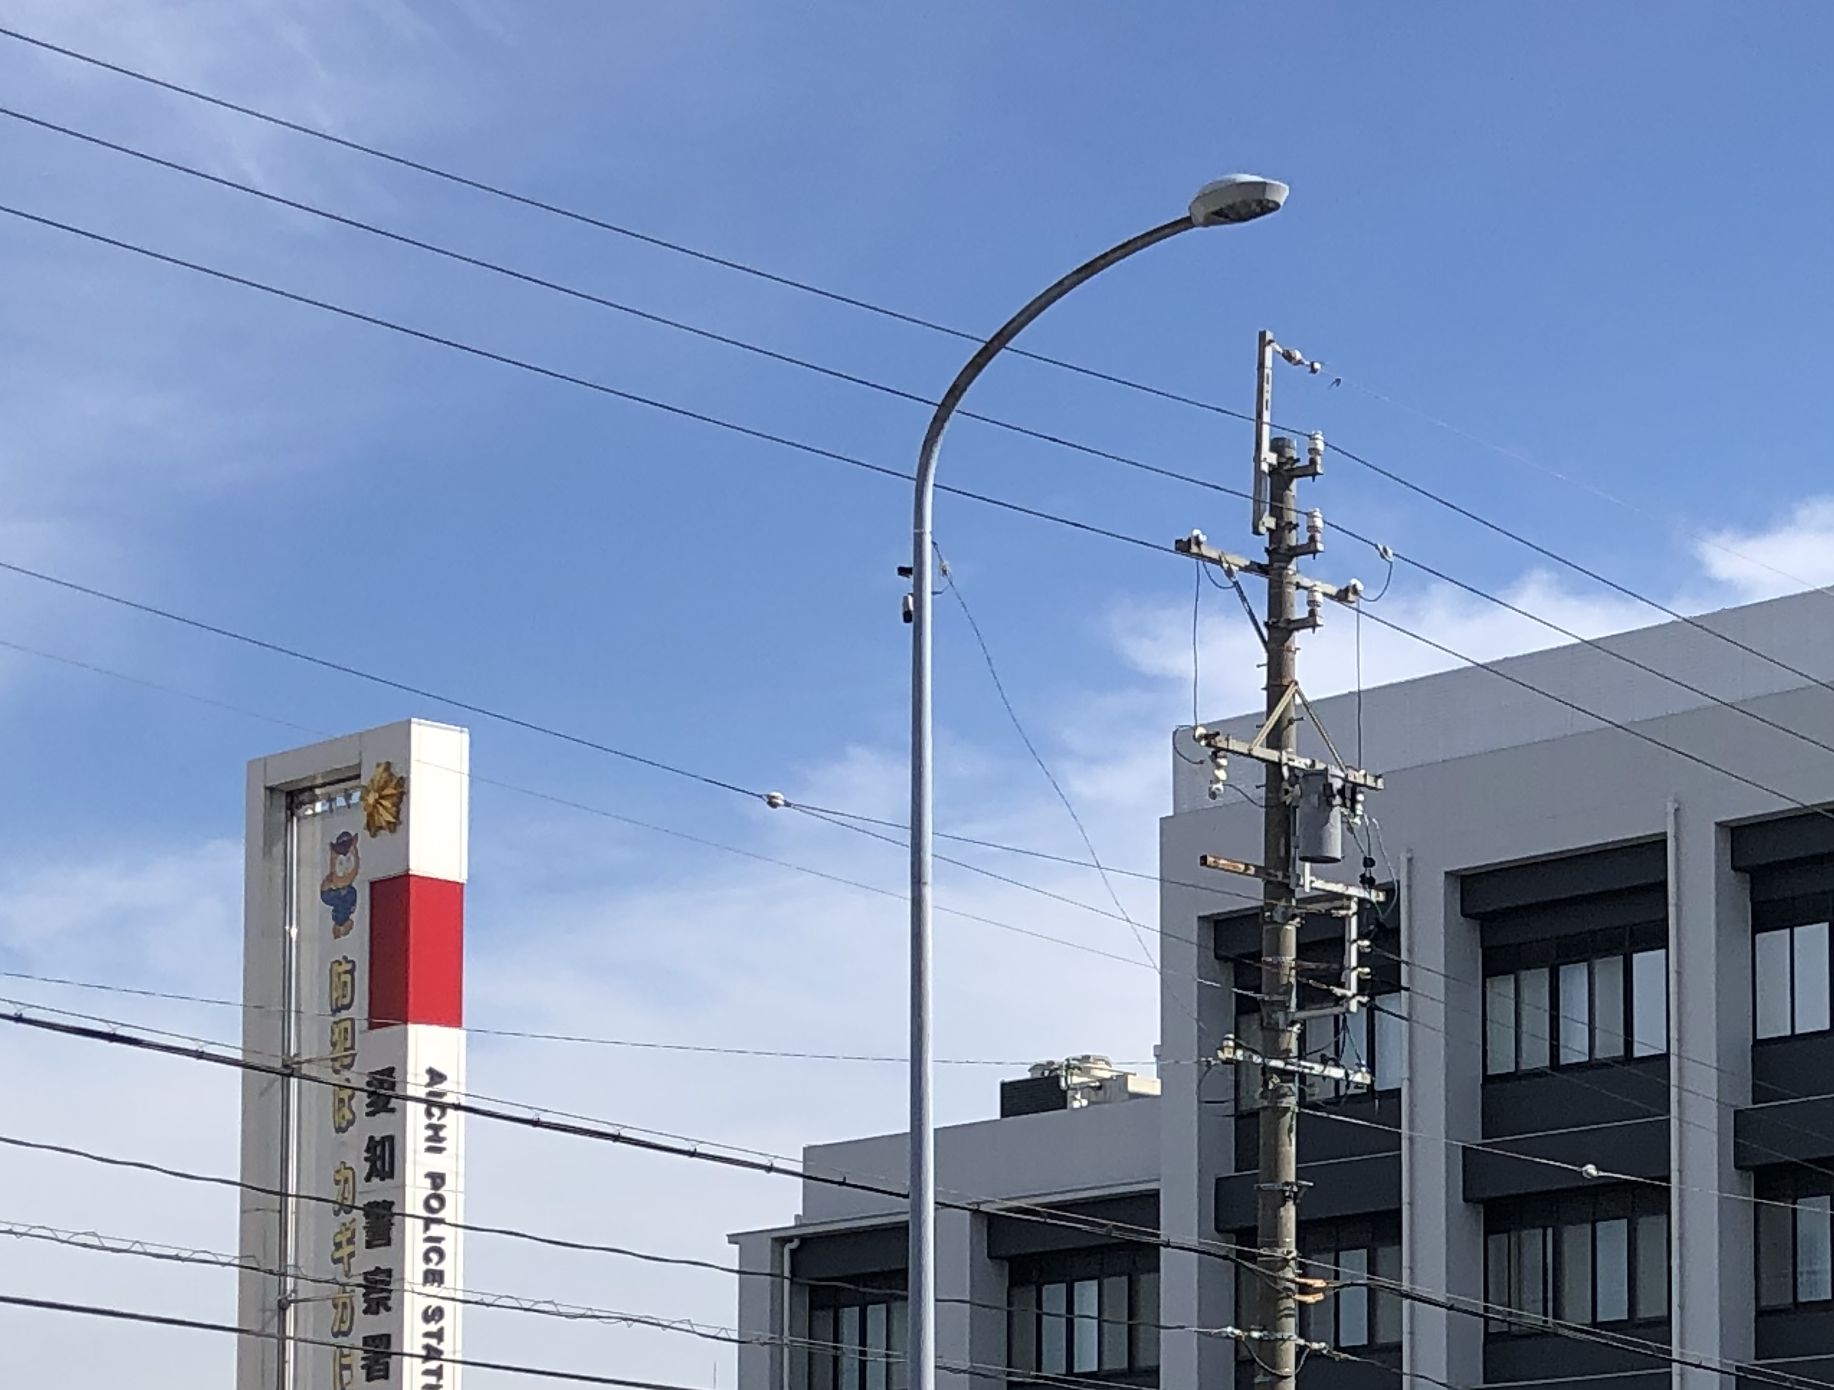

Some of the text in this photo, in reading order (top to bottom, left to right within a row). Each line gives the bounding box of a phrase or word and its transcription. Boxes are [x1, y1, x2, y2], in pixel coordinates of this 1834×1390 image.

[329, 955, 357, 1134] 防犯は
[424, 1066, 448, 1155] AICHI
[361, 1066, 397, 1383] 愛知警察署
[422, 1171, 447, 1288] POLICE
